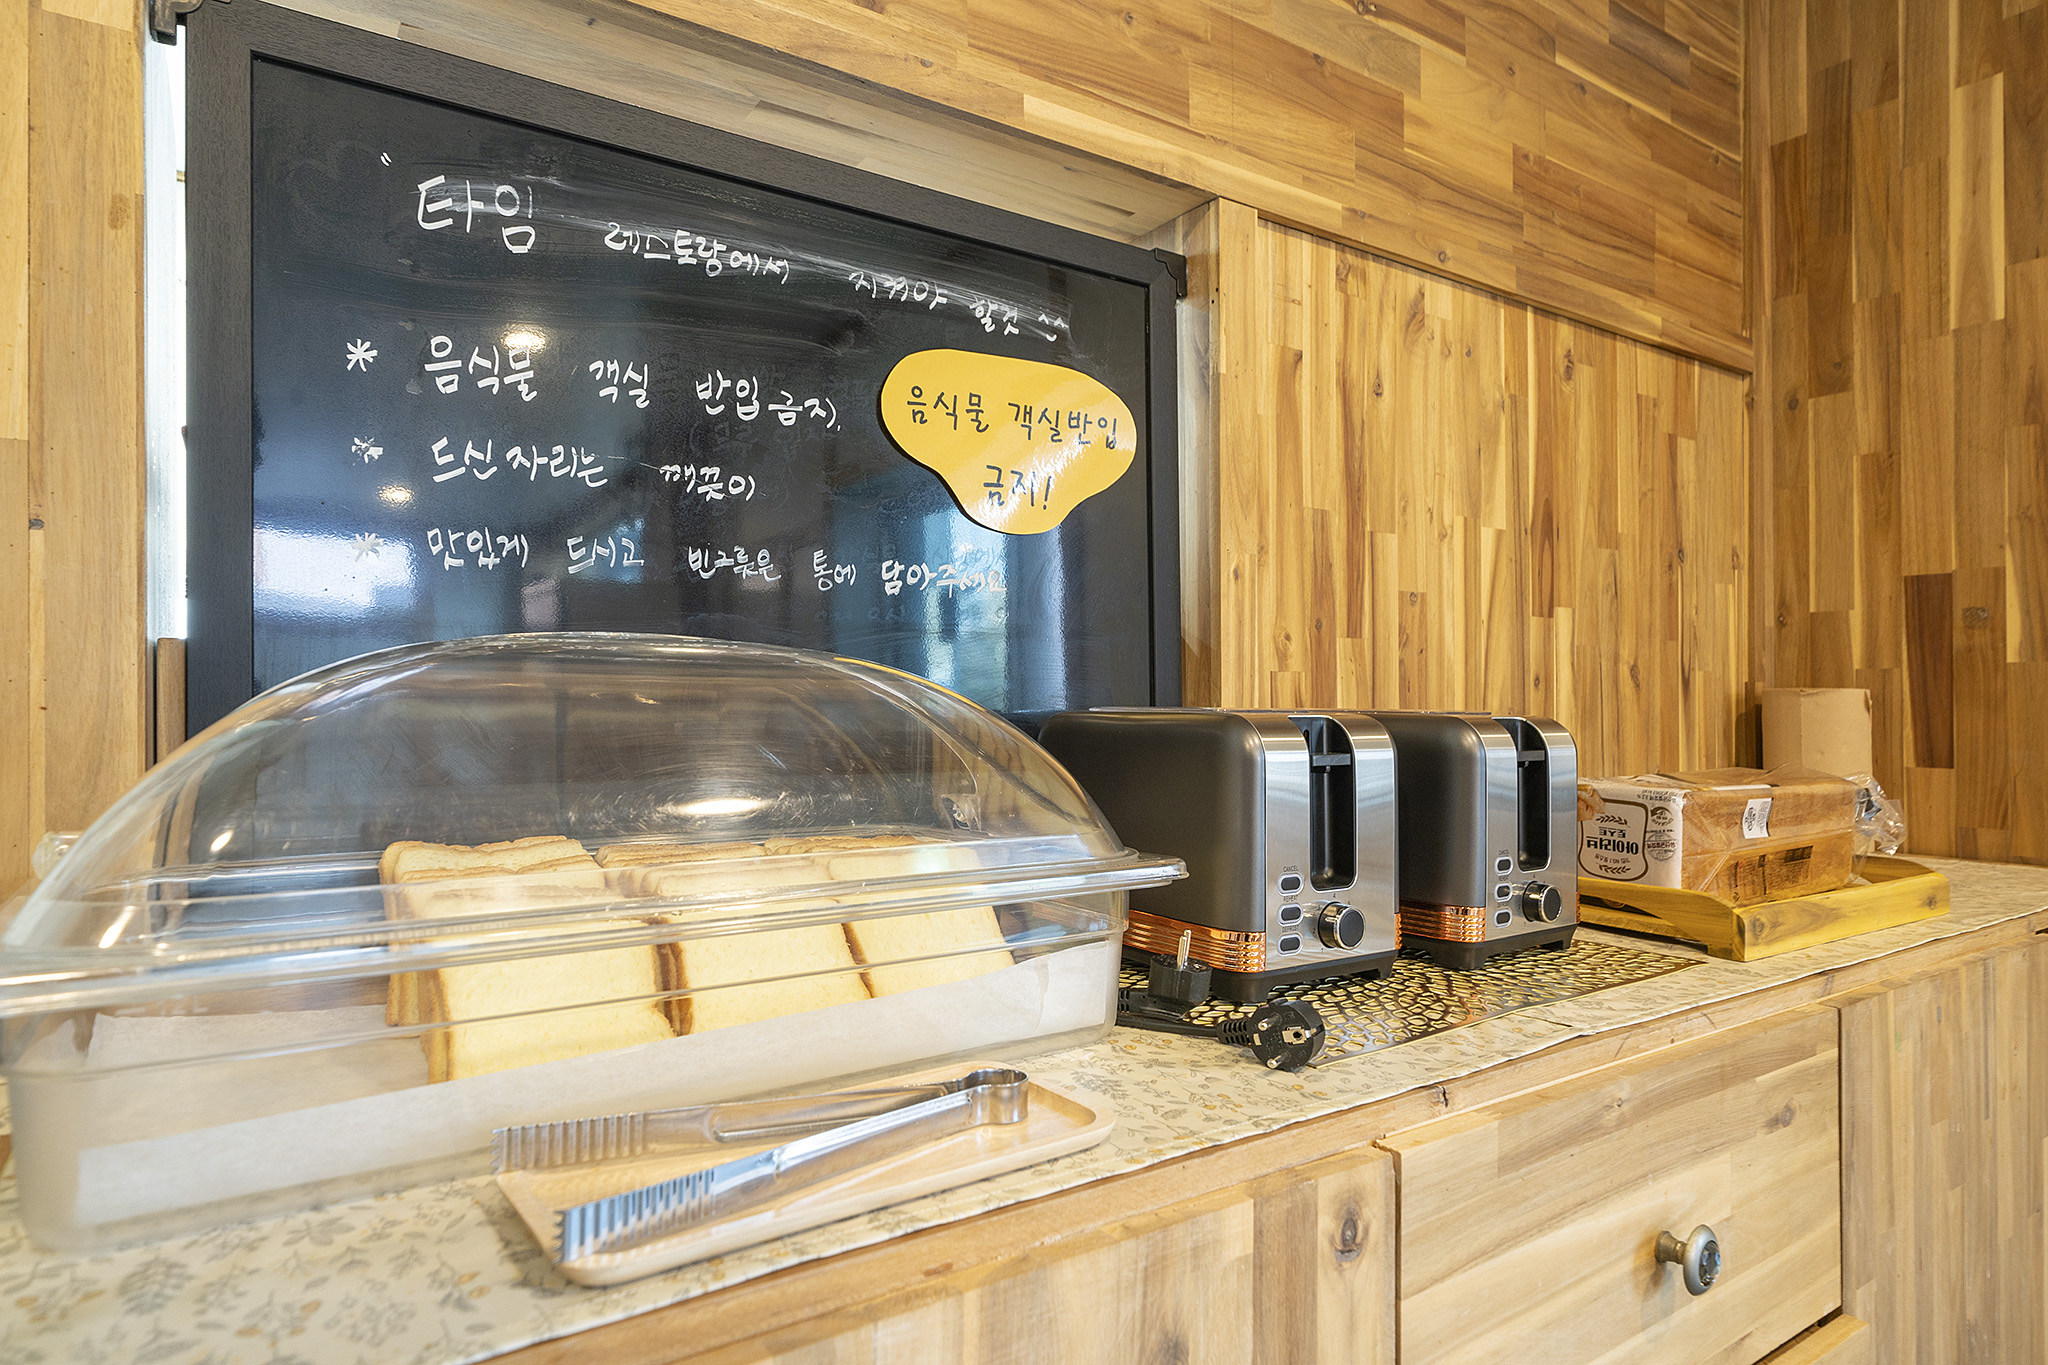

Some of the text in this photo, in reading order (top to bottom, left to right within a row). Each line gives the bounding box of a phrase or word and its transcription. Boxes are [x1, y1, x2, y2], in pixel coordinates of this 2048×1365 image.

[417, 174, 537, 254] 타임
[604, 222, 789, 285] 레스토랑에서
[849, 271, 948, 310] 지켜야
[424, 335, 538, 402] 음식물
[588, 358, 650, 410] 객실
[907, 385, 989, 433] 음식물
[983, 464, 1052, 510] 금지!
[813, 549, 857, 591] 통에
[1586, 835, 1639, 855] 아이러브
[1598, 826, 1626, 838] 토스트
[1283, 865, 1299, 873] CANCEL
[1283, 895, 1299, 903] REHEAT
